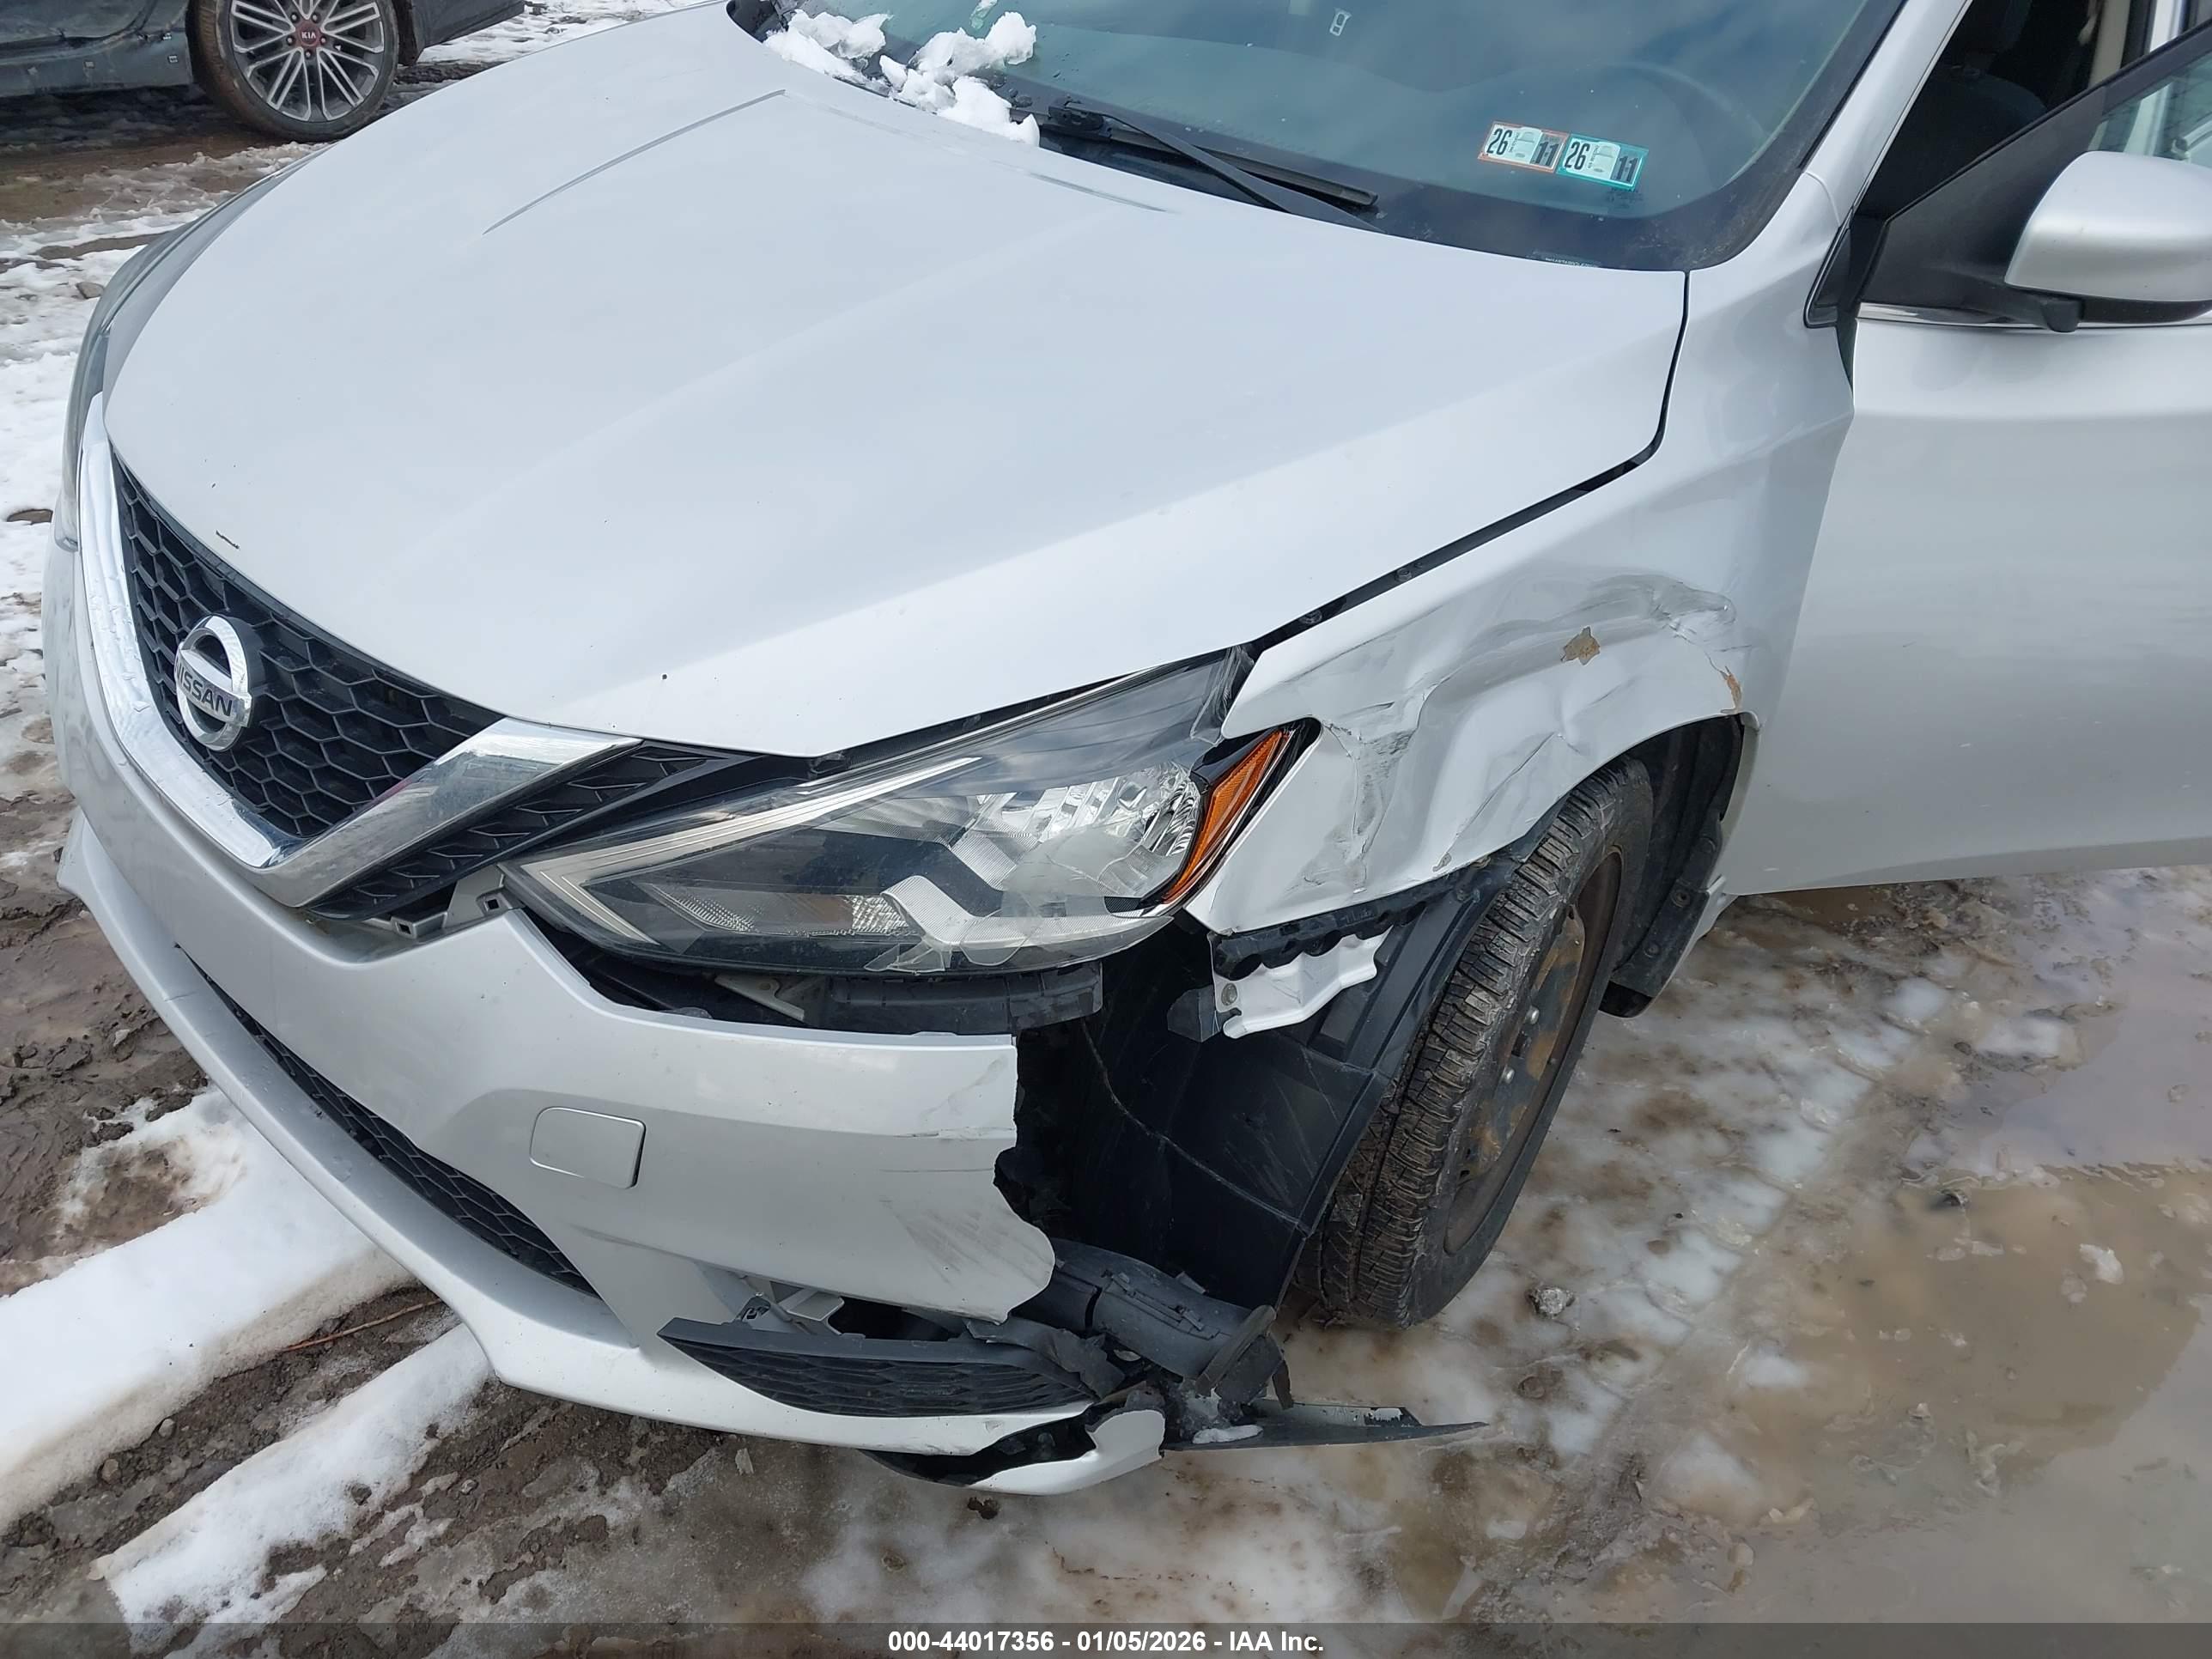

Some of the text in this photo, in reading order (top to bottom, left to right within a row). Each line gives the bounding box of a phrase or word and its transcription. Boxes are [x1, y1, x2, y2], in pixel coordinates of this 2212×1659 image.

[301, 31, 316, 40] KIA
[1486, 128, 1513, 155] 26
[1535, 141, 1559, 166] 11
[1564, 142, 1590, 170] 26
[1617, 155, 1638, 182] 11
[174, 657, 233, 716] NISSAN
